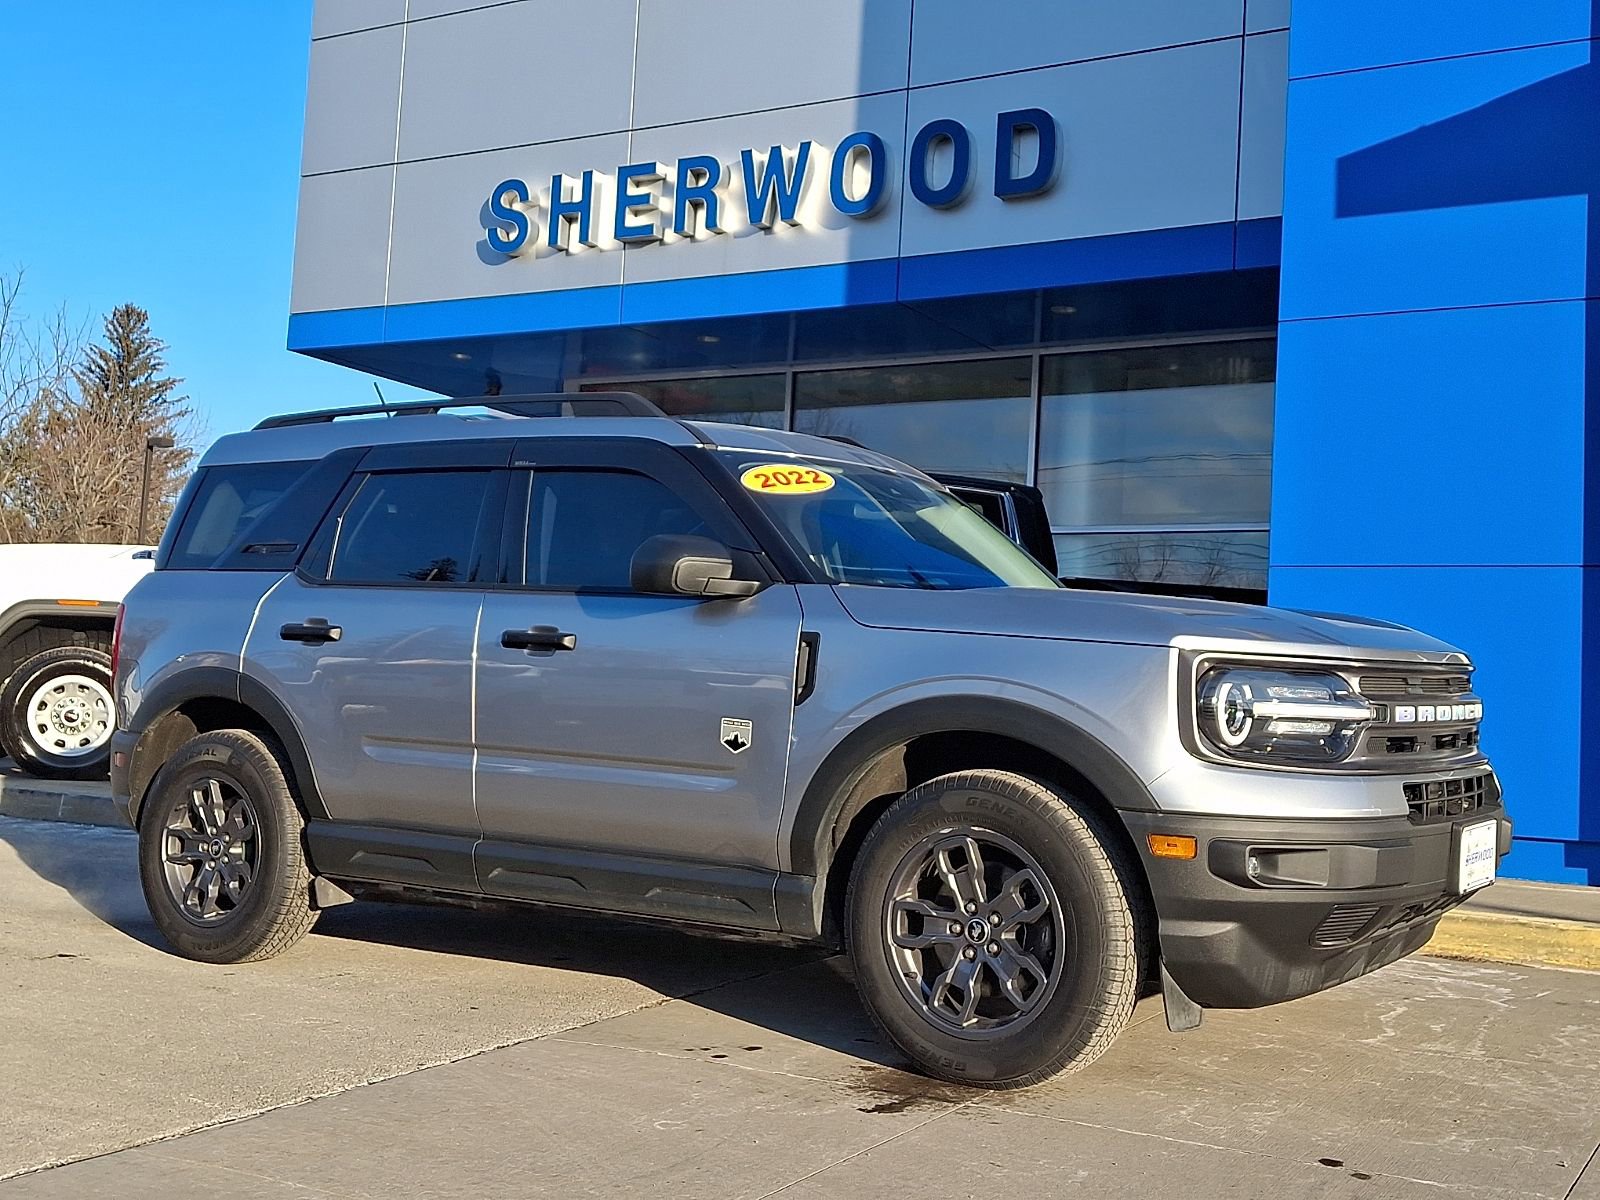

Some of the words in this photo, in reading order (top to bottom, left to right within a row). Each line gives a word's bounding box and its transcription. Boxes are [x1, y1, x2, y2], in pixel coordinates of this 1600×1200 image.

[486, 107, 1056, 256] SHERWOOD
[754, 470, 827, 489] 2022
[1395, 704, 1483, 722] BRONCO
